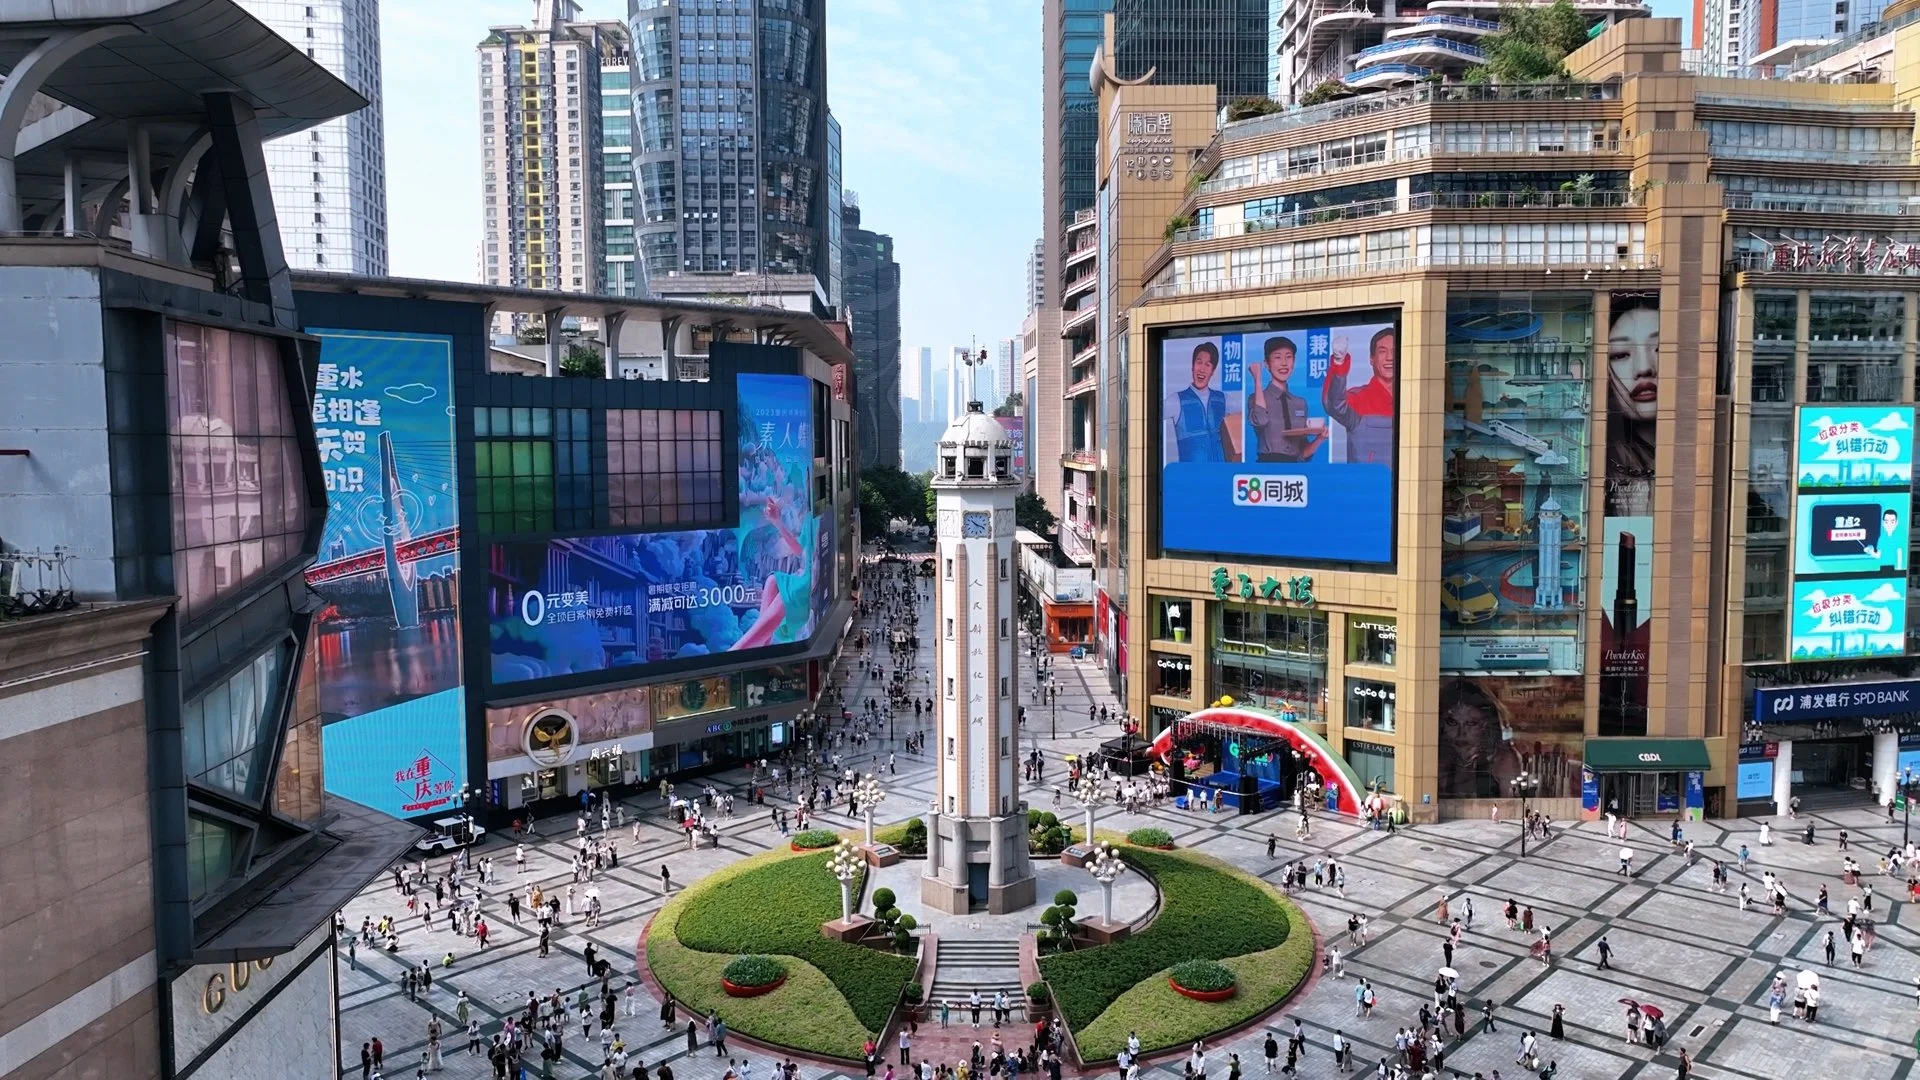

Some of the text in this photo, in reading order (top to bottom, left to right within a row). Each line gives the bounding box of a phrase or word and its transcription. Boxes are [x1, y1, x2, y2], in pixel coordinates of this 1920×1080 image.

[1223, 340, 1241, 383] 物流
[1308, 334, 1328, 380] 兼职
[1836, 438, 1888, 454] 纠错行动
[1236, 477, 1304, 503] 58同城
[522, 590, 590, 626] 0元变美
[648, 584, 756, 613] 满减可达3000元
[547, 605, 634, 624] 全项目案例免费打造
[1829, 609, 1881, 627] 纠错行动
[1378, 632, 1396, 640] coff
[1800, 689, 1910, 710] 浦发银行 SPD BANK
[589, 743, 623, 760] 周六福
[395, 767, 415, 783] 我在
